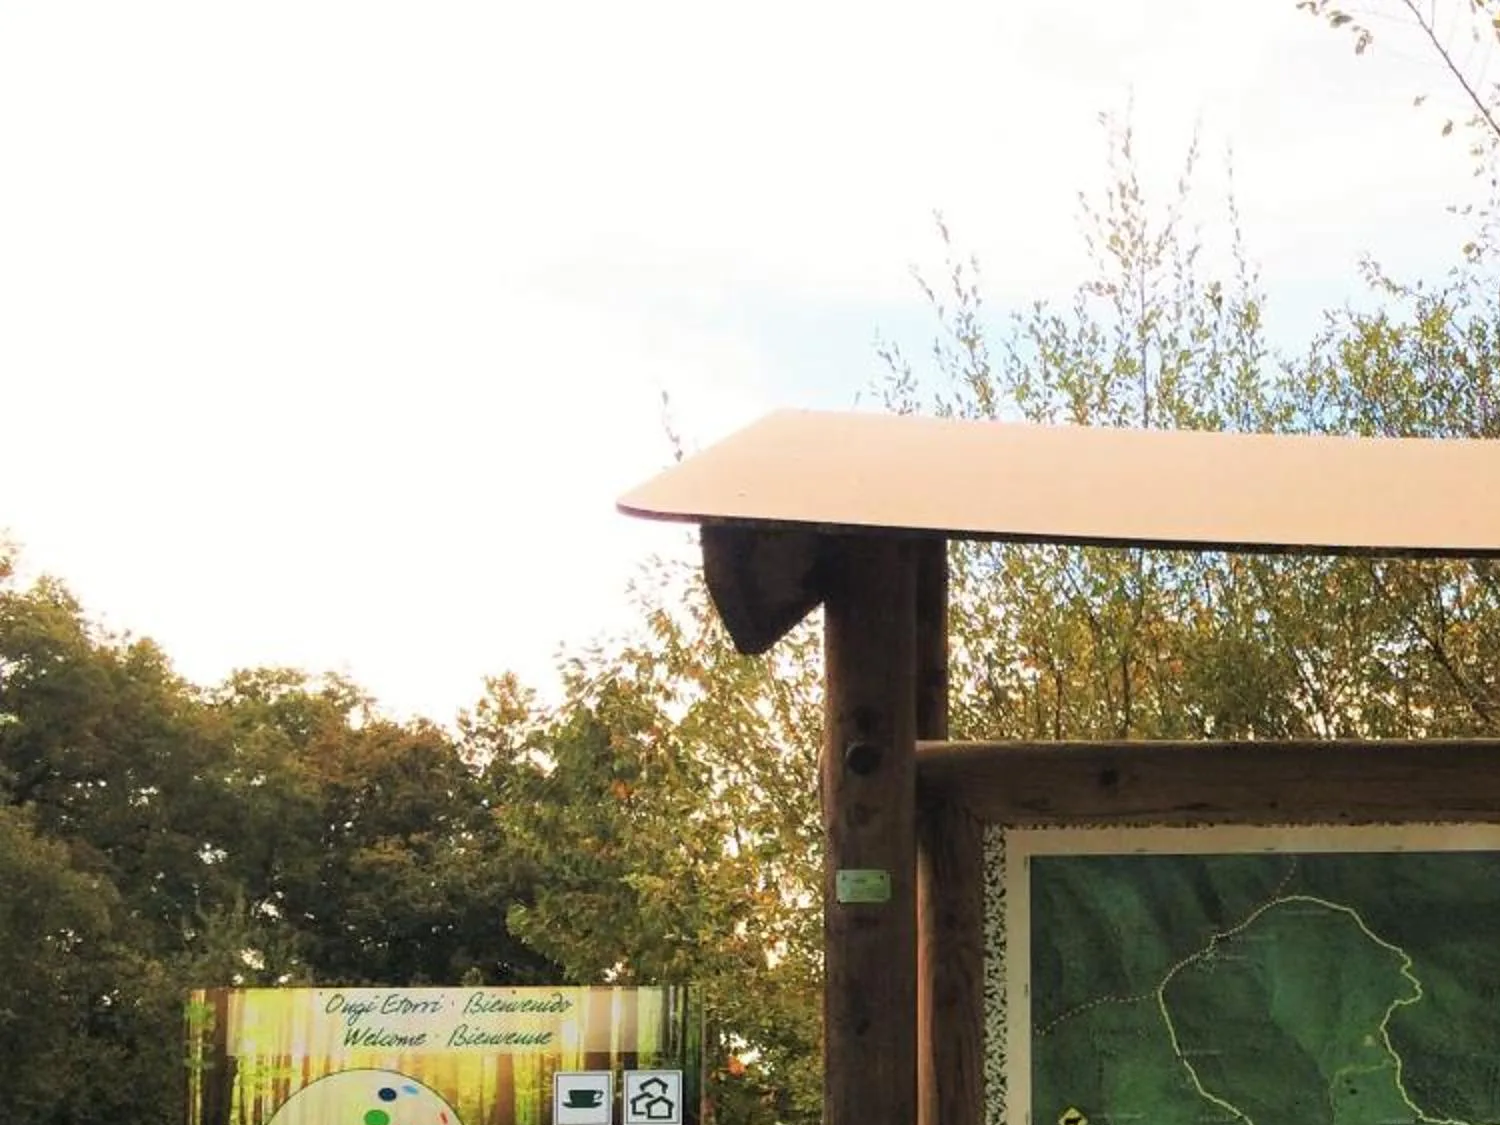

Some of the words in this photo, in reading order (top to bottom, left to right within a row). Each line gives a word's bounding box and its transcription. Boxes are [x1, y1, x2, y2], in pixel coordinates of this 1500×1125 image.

[380, 992, 444, 1016] Etorri
[463, 990, 573, 1017] Bienvenido
[343, 1028, 427, 1048] Welcome
[447, 1027, 553, 1047] Bienvenue
